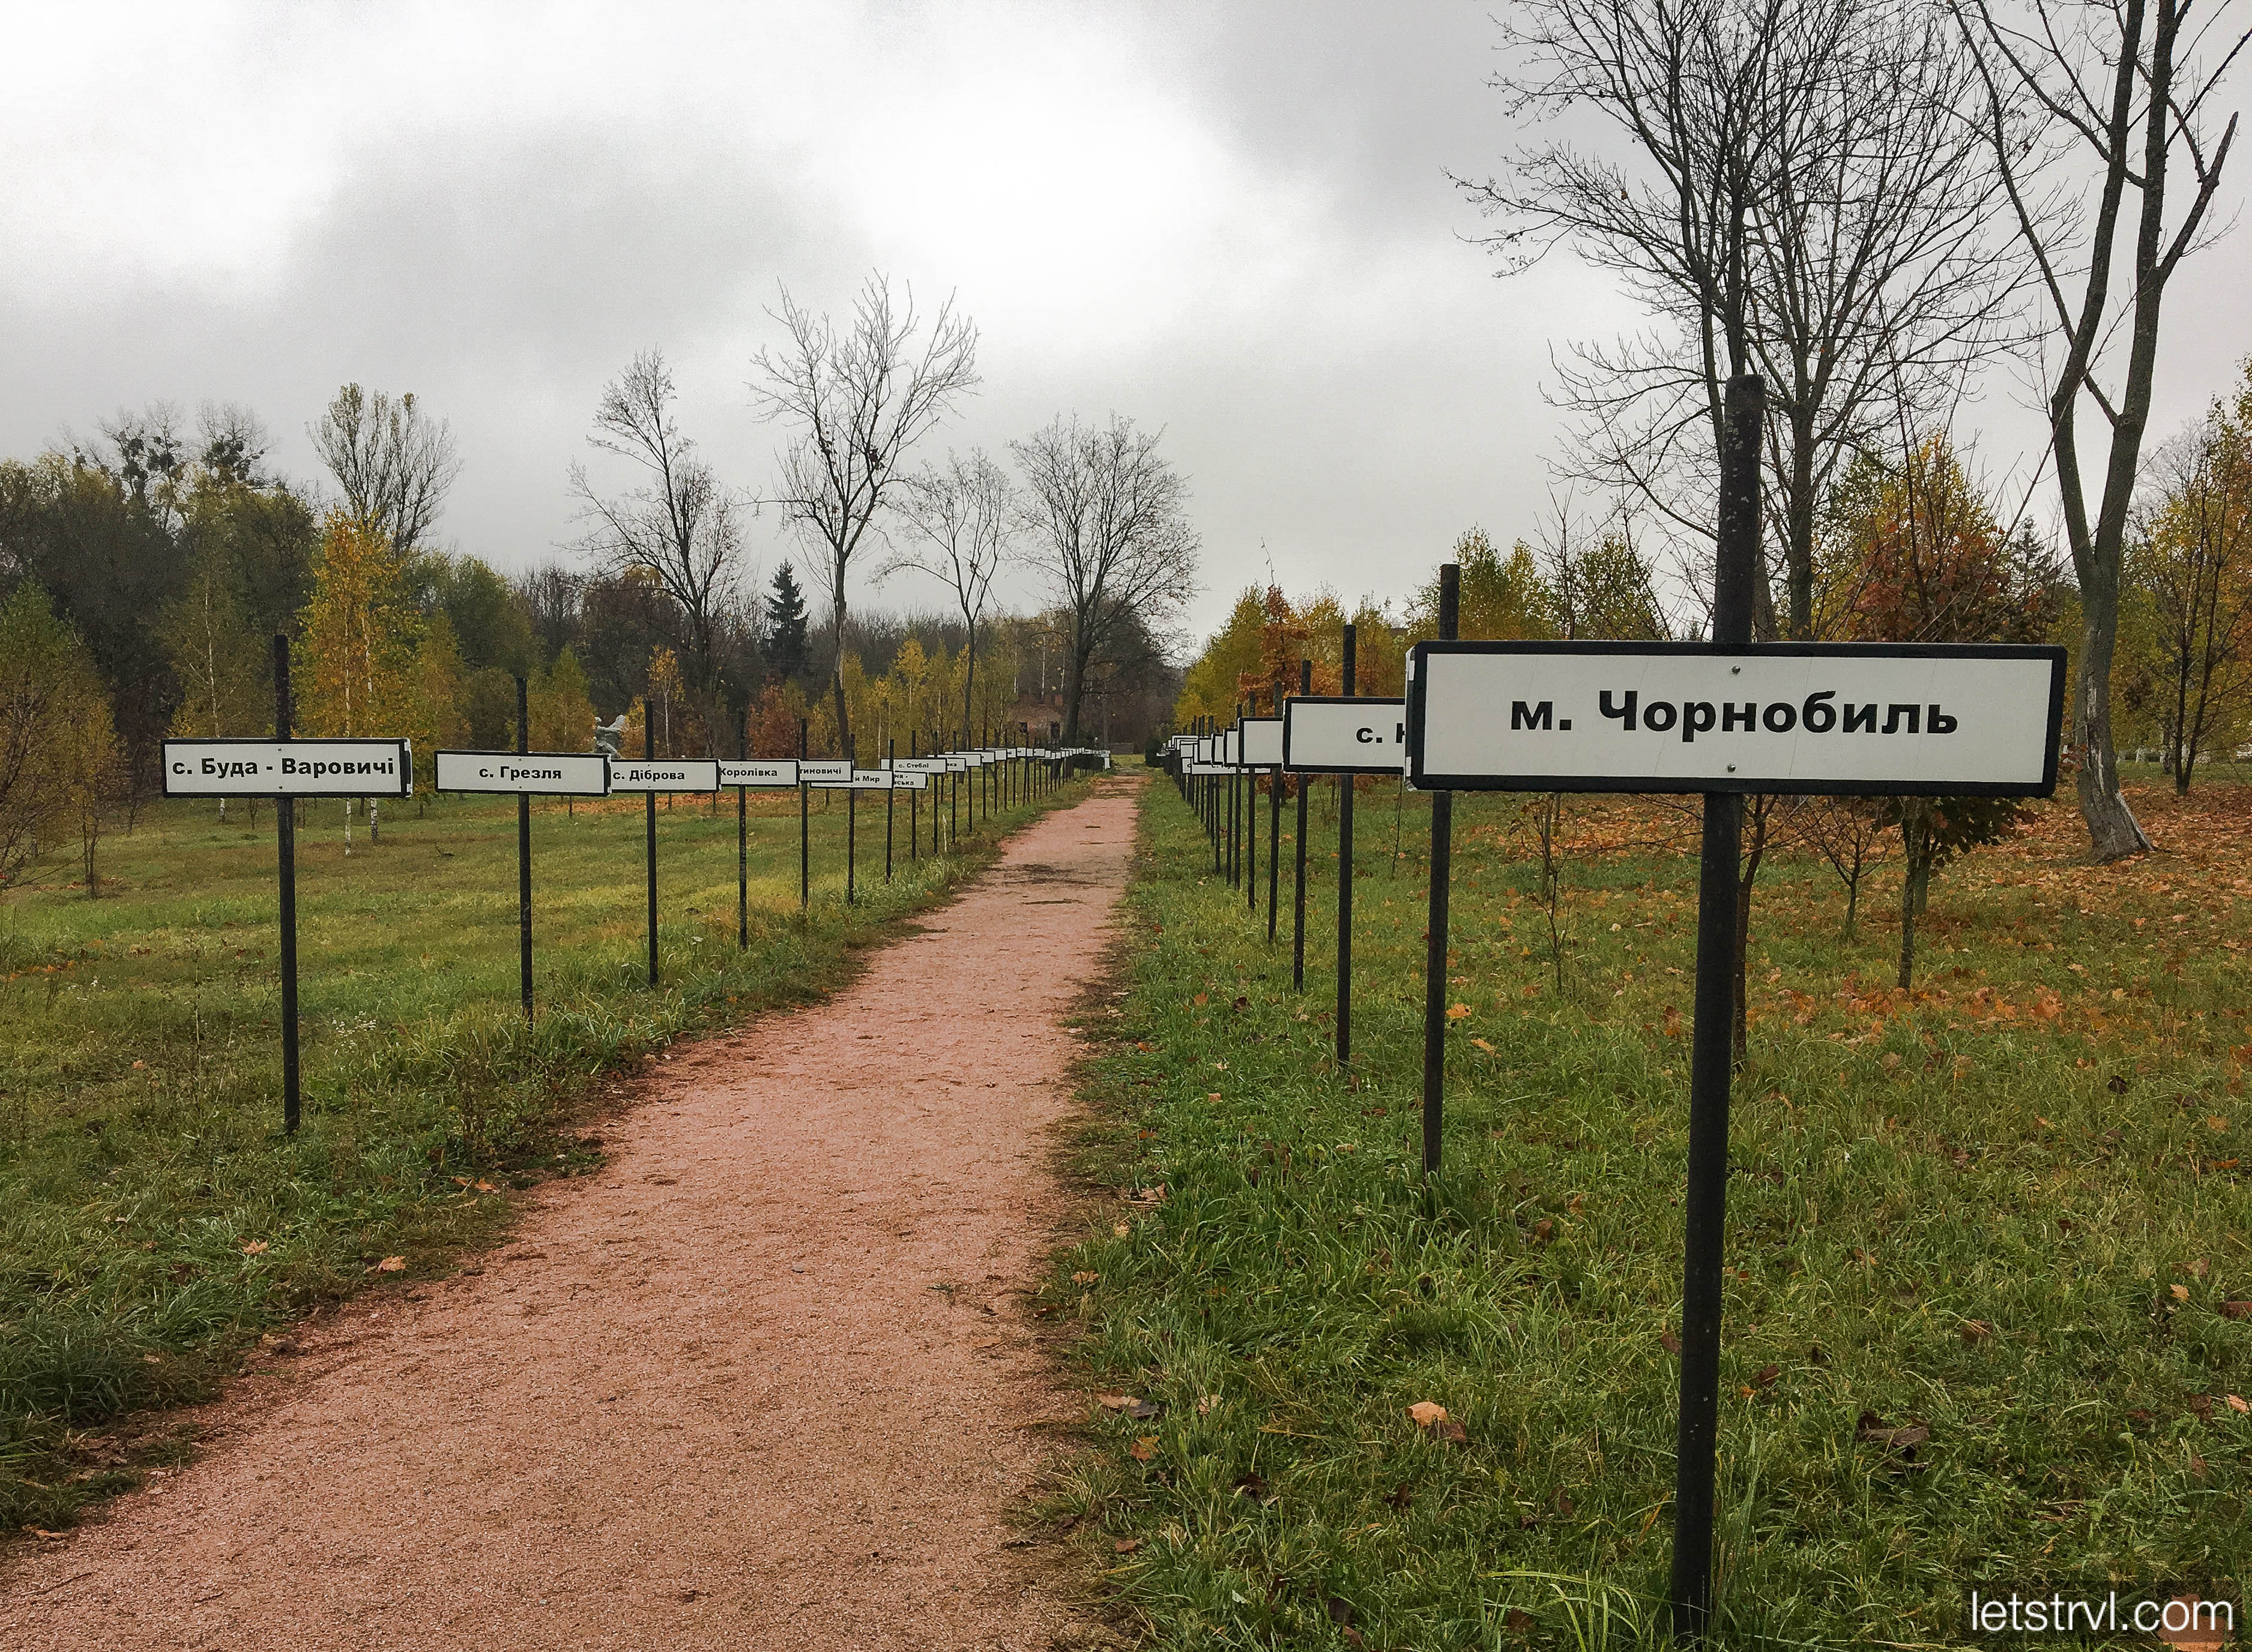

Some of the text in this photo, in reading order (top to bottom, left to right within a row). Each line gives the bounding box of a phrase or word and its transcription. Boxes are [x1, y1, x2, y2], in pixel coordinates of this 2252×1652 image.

[1510, 689, 1958, 743] м. Чорнобиль
[1356, 727, 1383, 744] с.
[172, 762, 193, 775] с.
[201, 758, 258, 779] Буда
[282, 757, 394, 779] Варовичі
[478, 765, 562, 782] с. Грезля
[629, 770, 685, 782] Діброва
[862, 775, 880, 783] Мир
